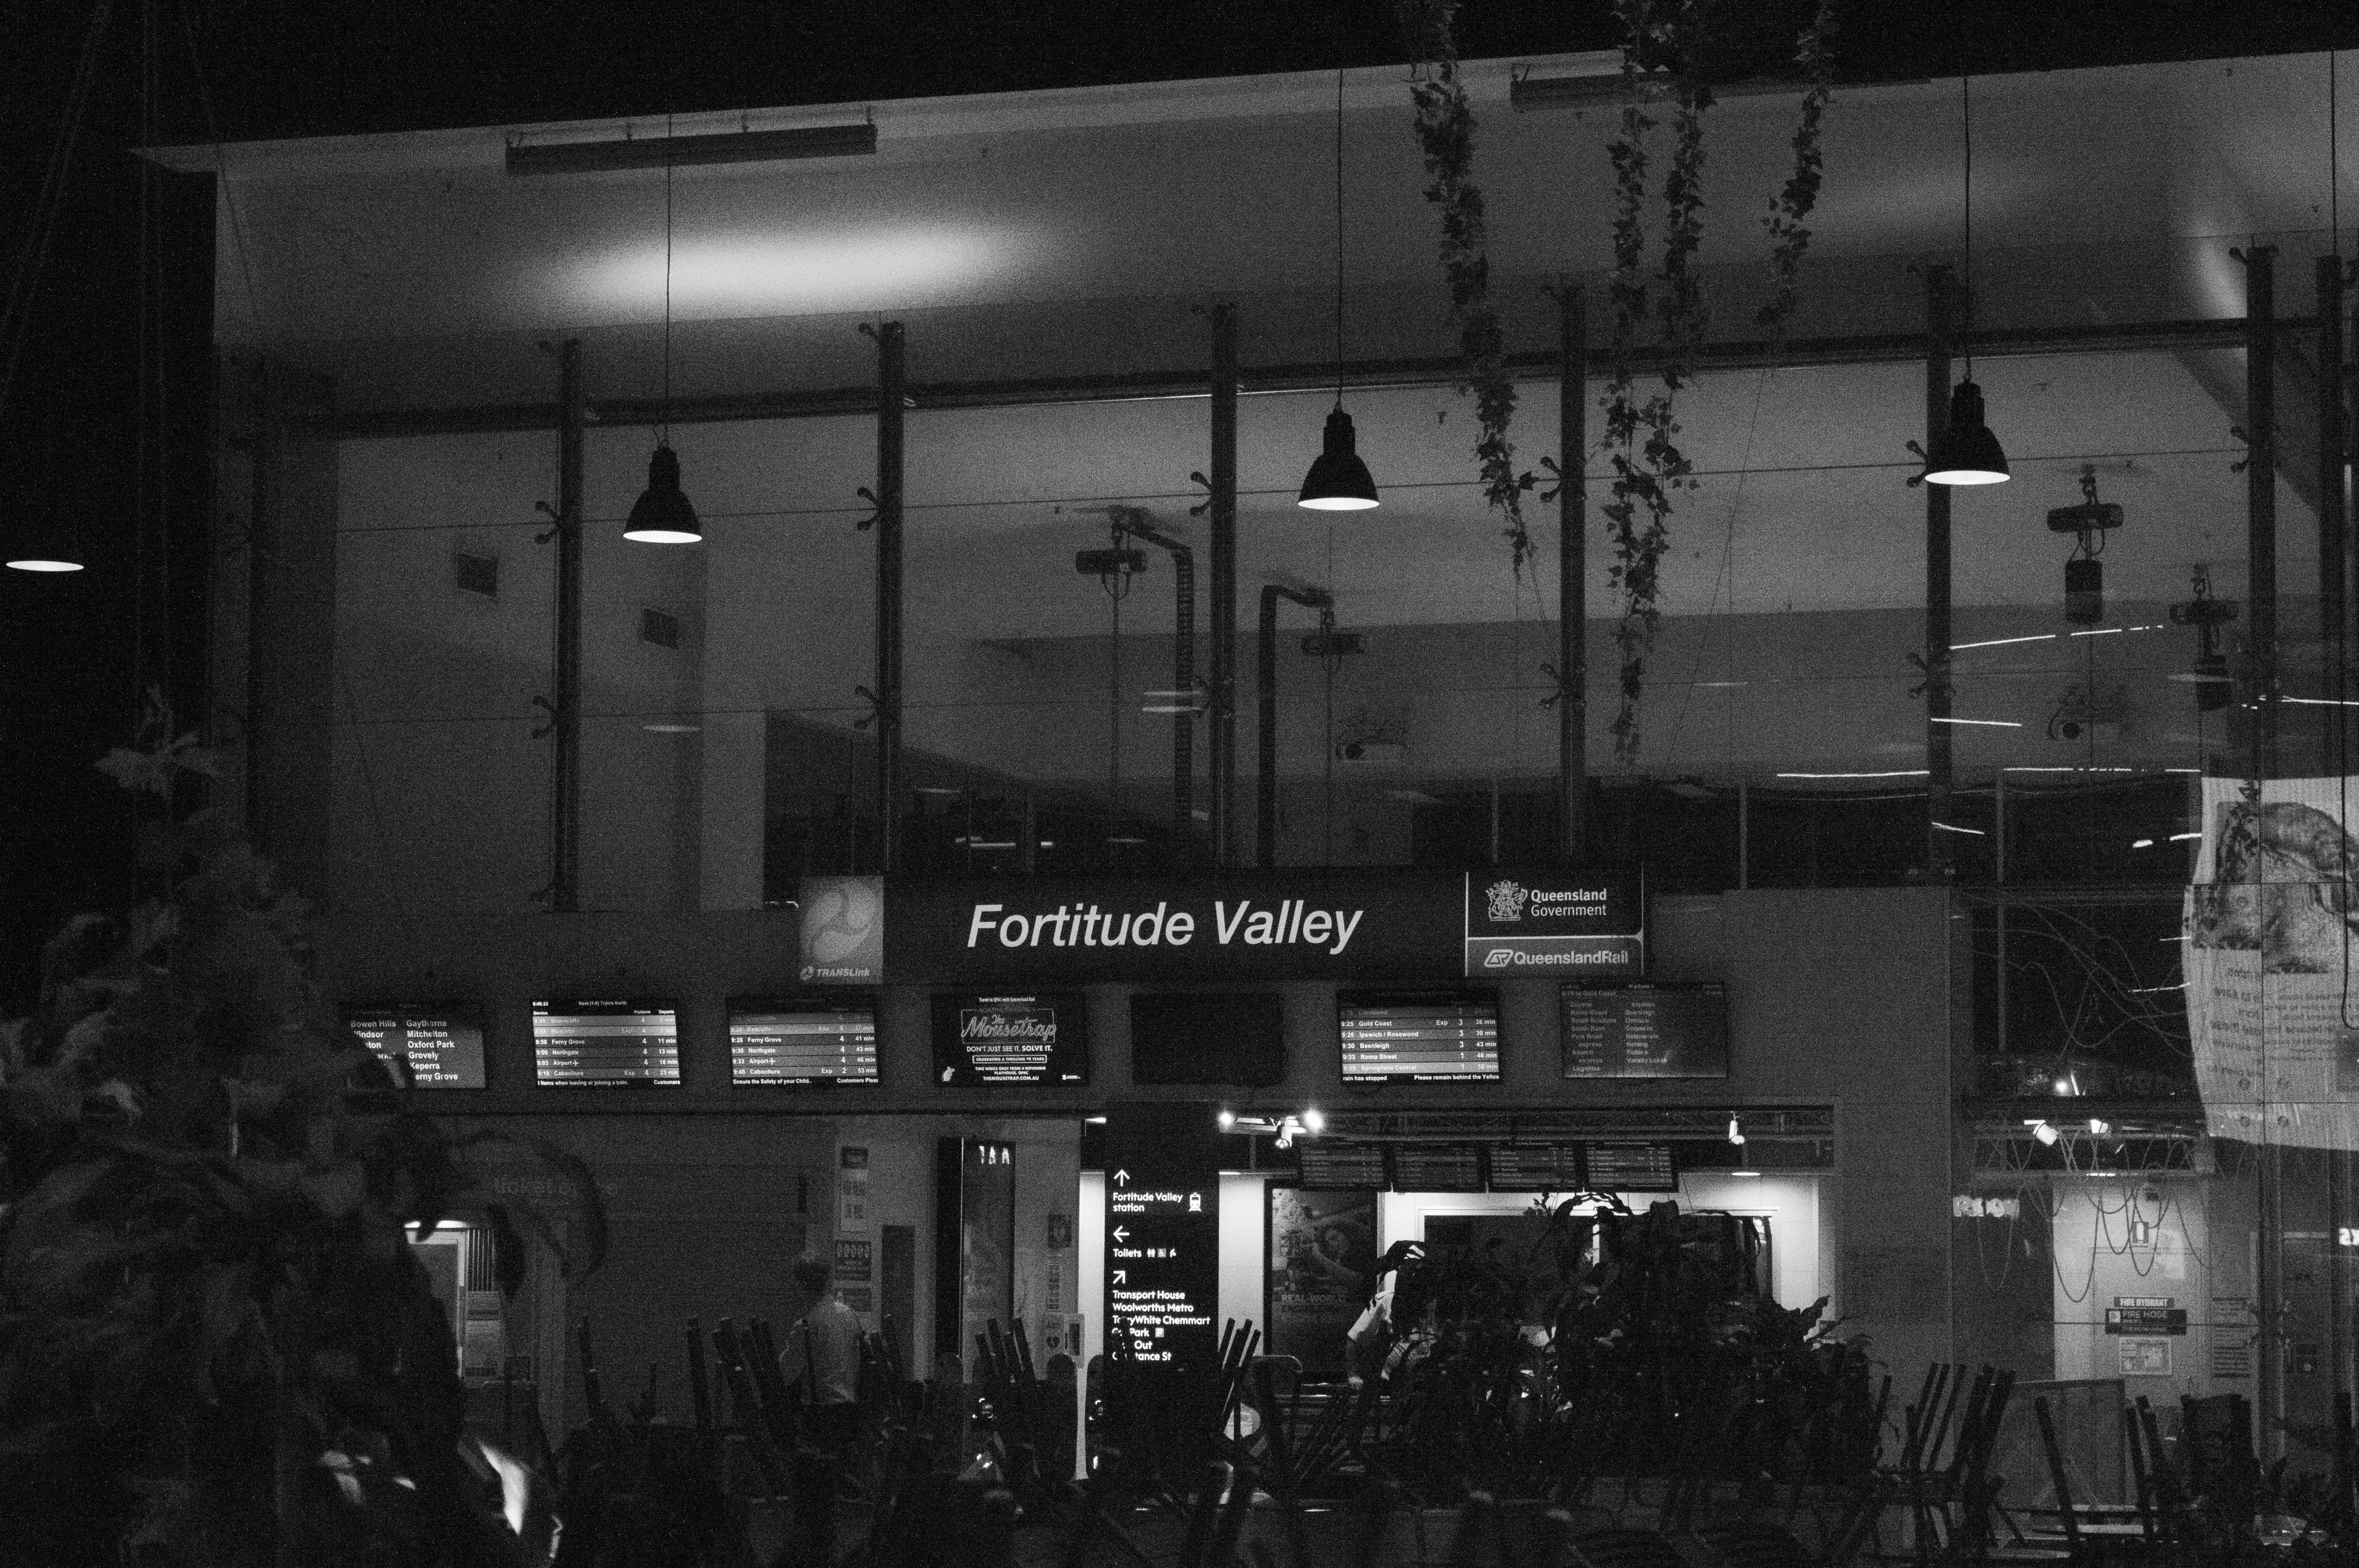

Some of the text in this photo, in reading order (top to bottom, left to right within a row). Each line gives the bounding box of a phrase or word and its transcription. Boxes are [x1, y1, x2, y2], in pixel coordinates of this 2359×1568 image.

[1531, 888, 1607, 903] Queensland
[1531, 905, 1607, 916] Government
[968, 900, 1364, 955] Fortitude Valley
[817, 968, 870, 977] TRANSLink
[406, 1020, 447, 1028] Gaythorne
[992, 1014, 1005, 1024] The
[961, 1016, 1057, 1041] Mousetrap
[408, 1051, 439, 1061] Grovely
[434, 1072, 458, 1080] Grove
[1113, 1192, 1184, 1203] Fortitude Valley
[1113, 1203, 1144, 1212] station
[1113, 1248, 1142, 1258] Toilets
[1113, 1290, 1185, 1301] Transport House
[1112, 1303, 1194, 1312] Woolworths Metro
[1162, 1315, 1211, 1325] Chemmart
[1129, 1328, 1150, 1337] Park
[1134, 1340, 1153, 1350] Out
[1162, 1351, 1172, 1361] St
